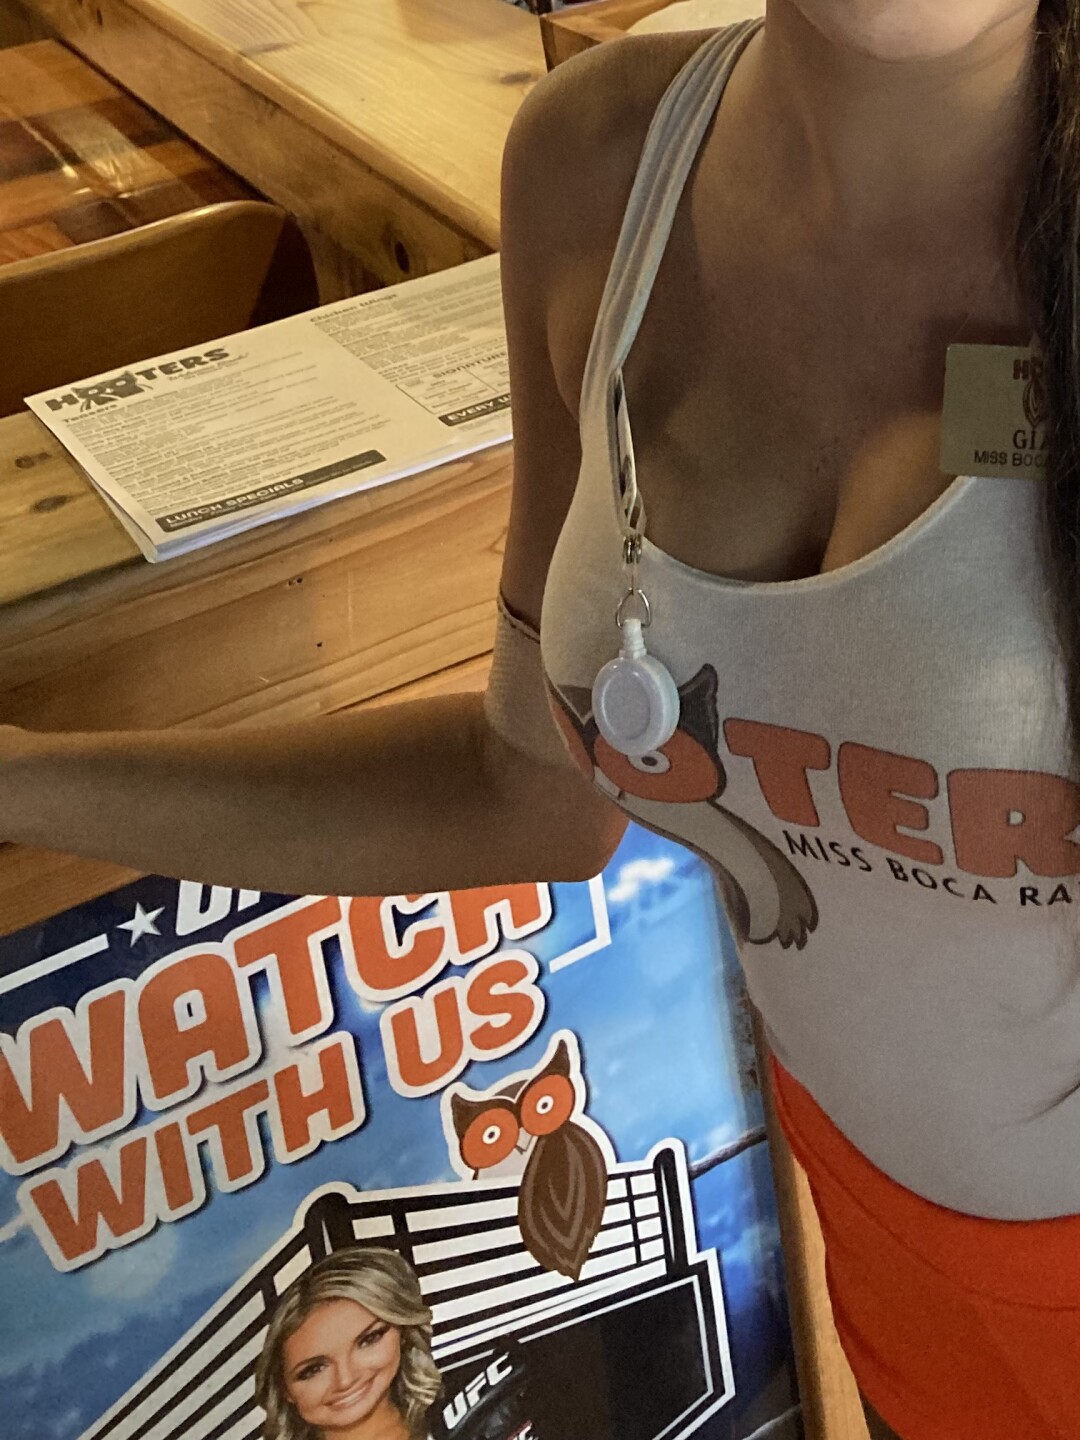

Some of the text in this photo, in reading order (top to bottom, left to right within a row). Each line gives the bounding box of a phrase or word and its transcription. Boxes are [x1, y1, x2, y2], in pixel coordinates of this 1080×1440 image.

[974, 449, 1051, 469] MISS BOC
[166, 477, 305, 524] LUNCH SPECIALS
[782, 830, 872, 873] MISS
[886, 857, 998, 905] BOCA
[389, 957, 538, 1089] US
[29, 1041, 357, 1262] WITH
[442, 1352, 513, 1430] UFC
